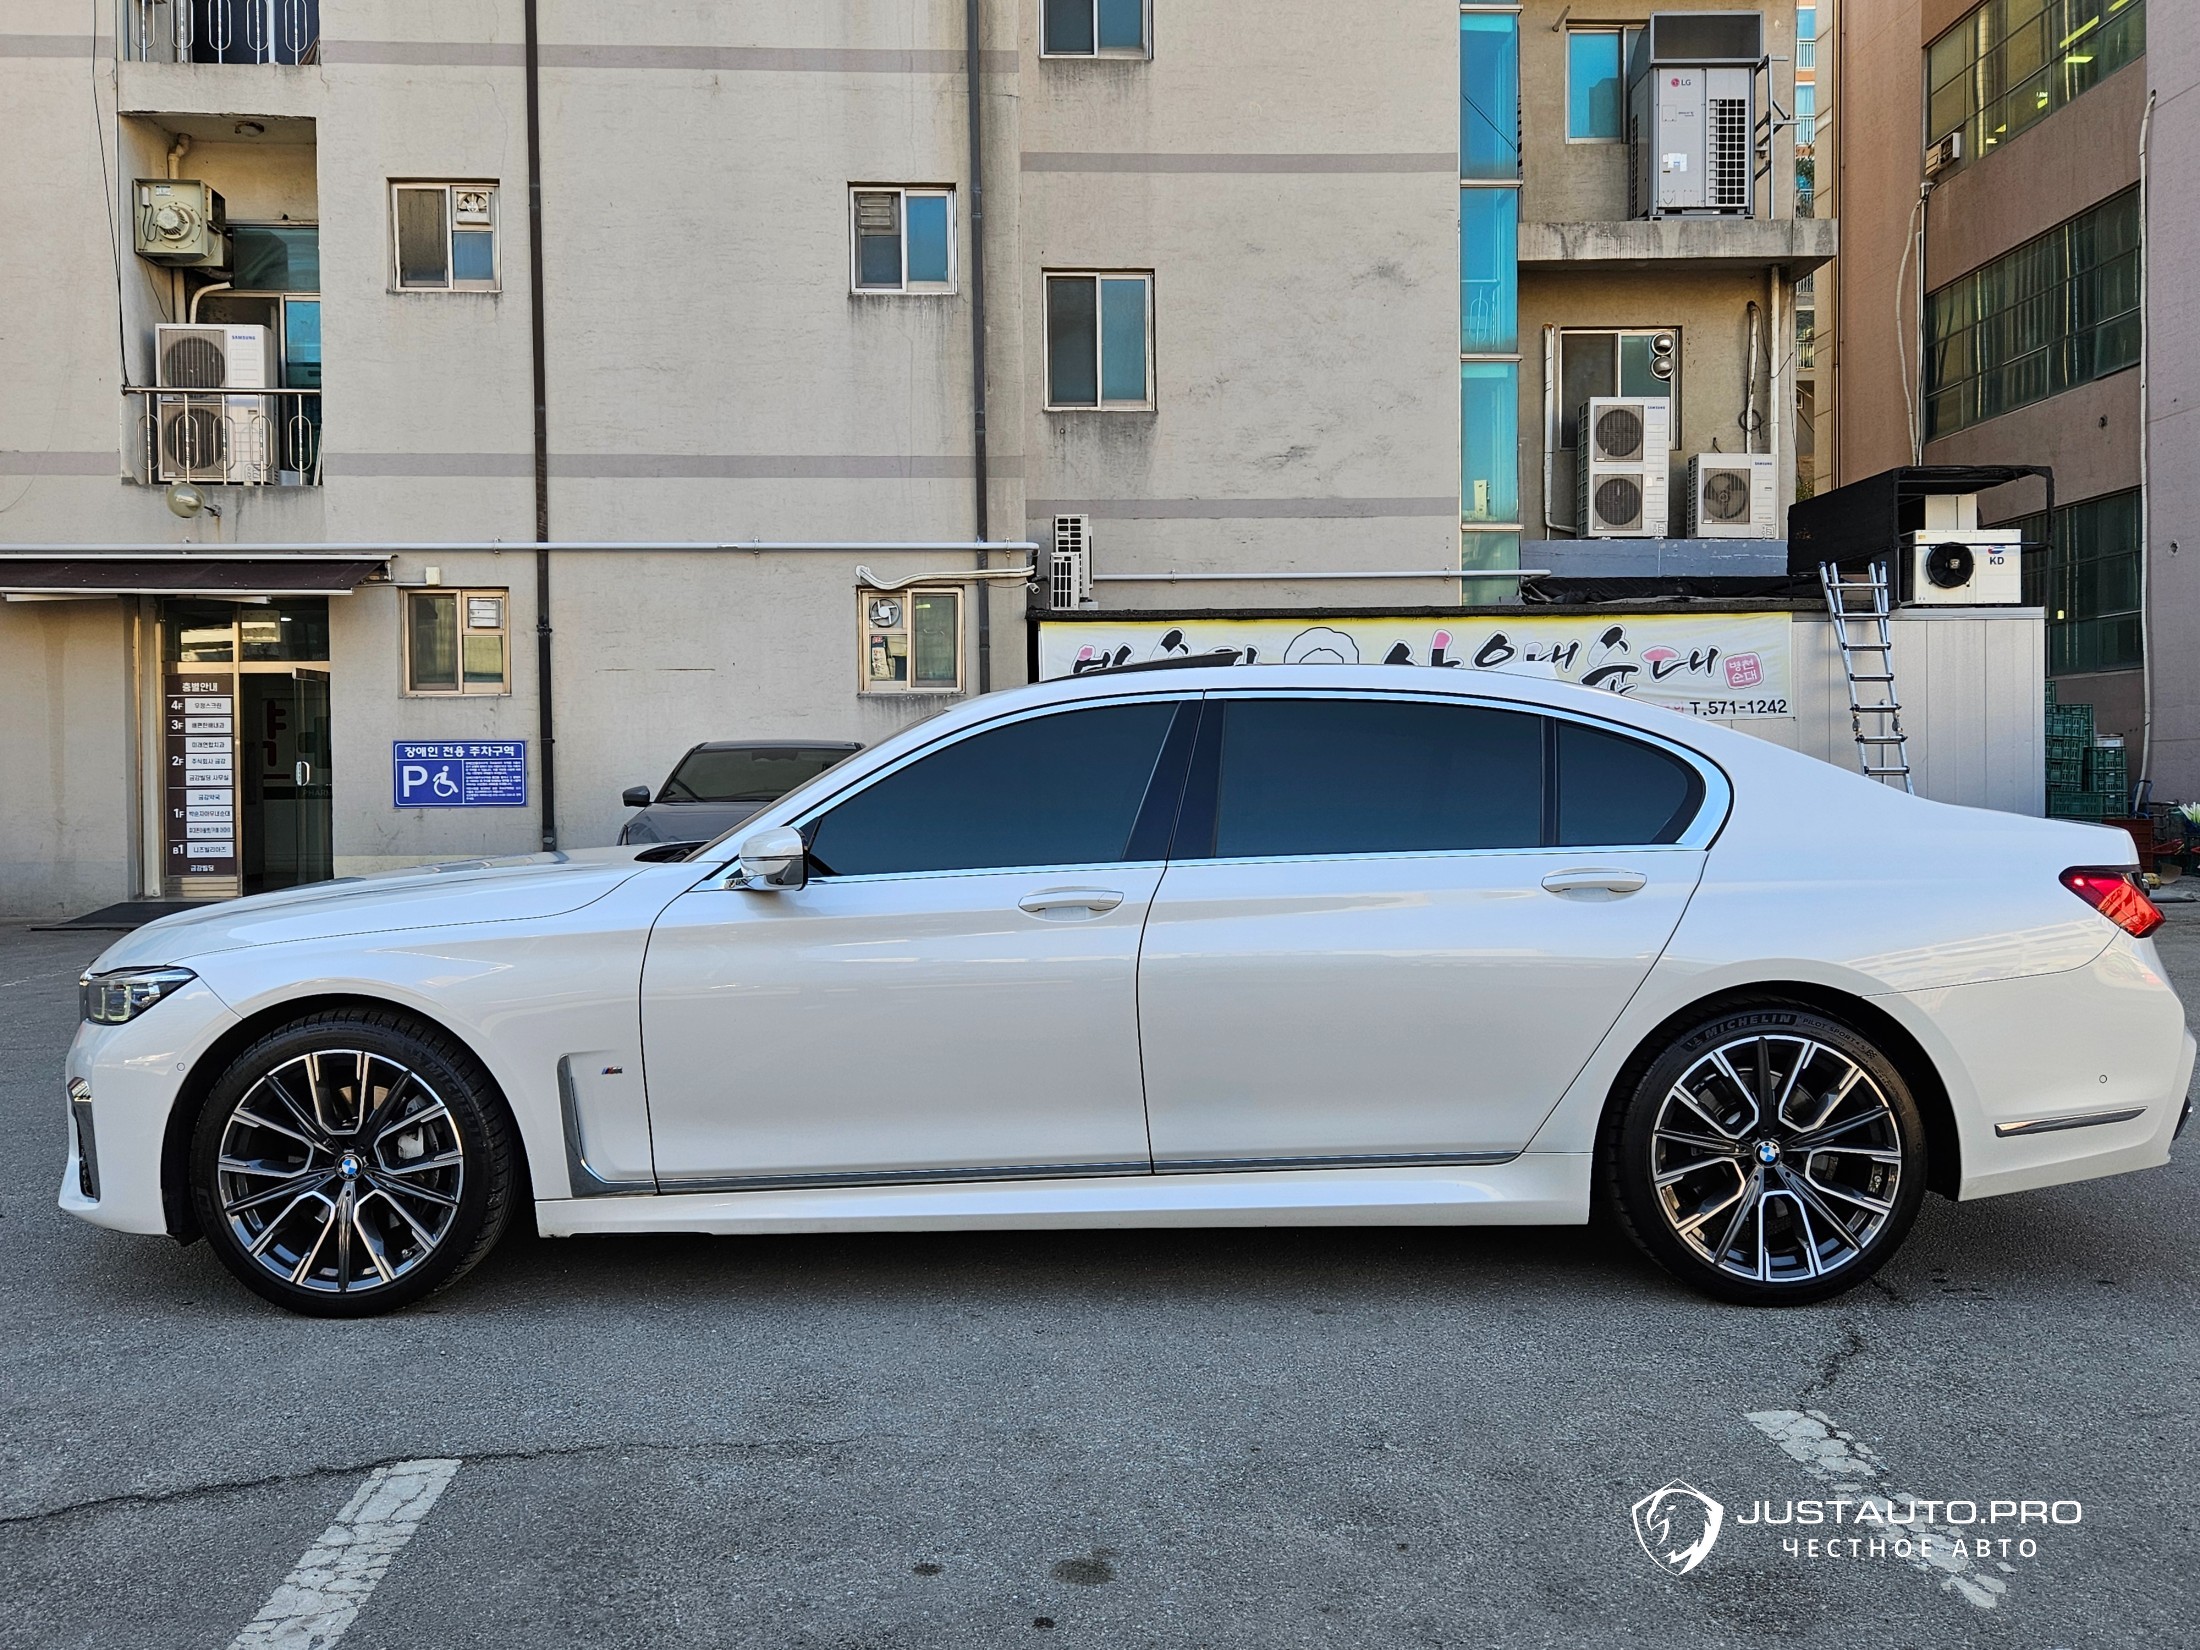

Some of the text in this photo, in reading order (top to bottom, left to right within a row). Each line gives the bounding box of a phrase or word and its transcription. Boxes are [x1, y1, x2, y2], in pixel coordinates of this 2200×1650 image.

[1989, 556, 2005, 565] KD
[1729, 659, 1754, 671] 병천
[1732, 669, 1757, 683] 순대
[182, 682, 218, 692] 층별안내
[171, 700, 184, 710] 4F
[1689, 699, 1788, 716] T.571-1242
[171, 720, 184, 730] 3F
[404, 745, 515, 758] 장애인 전용 주차구역
[171, 755, 184, 766] 2F
[403, 765, 428, 797] P
[173, 808, 185, 818] 1F
[172, 844, 184, 854] B1
[1704, 1014, 1791, 1038] MICHELIN
[1802, 1018, 1826, 1029] PILOT
[1829, 1026, 1855, 1043] SPORT
